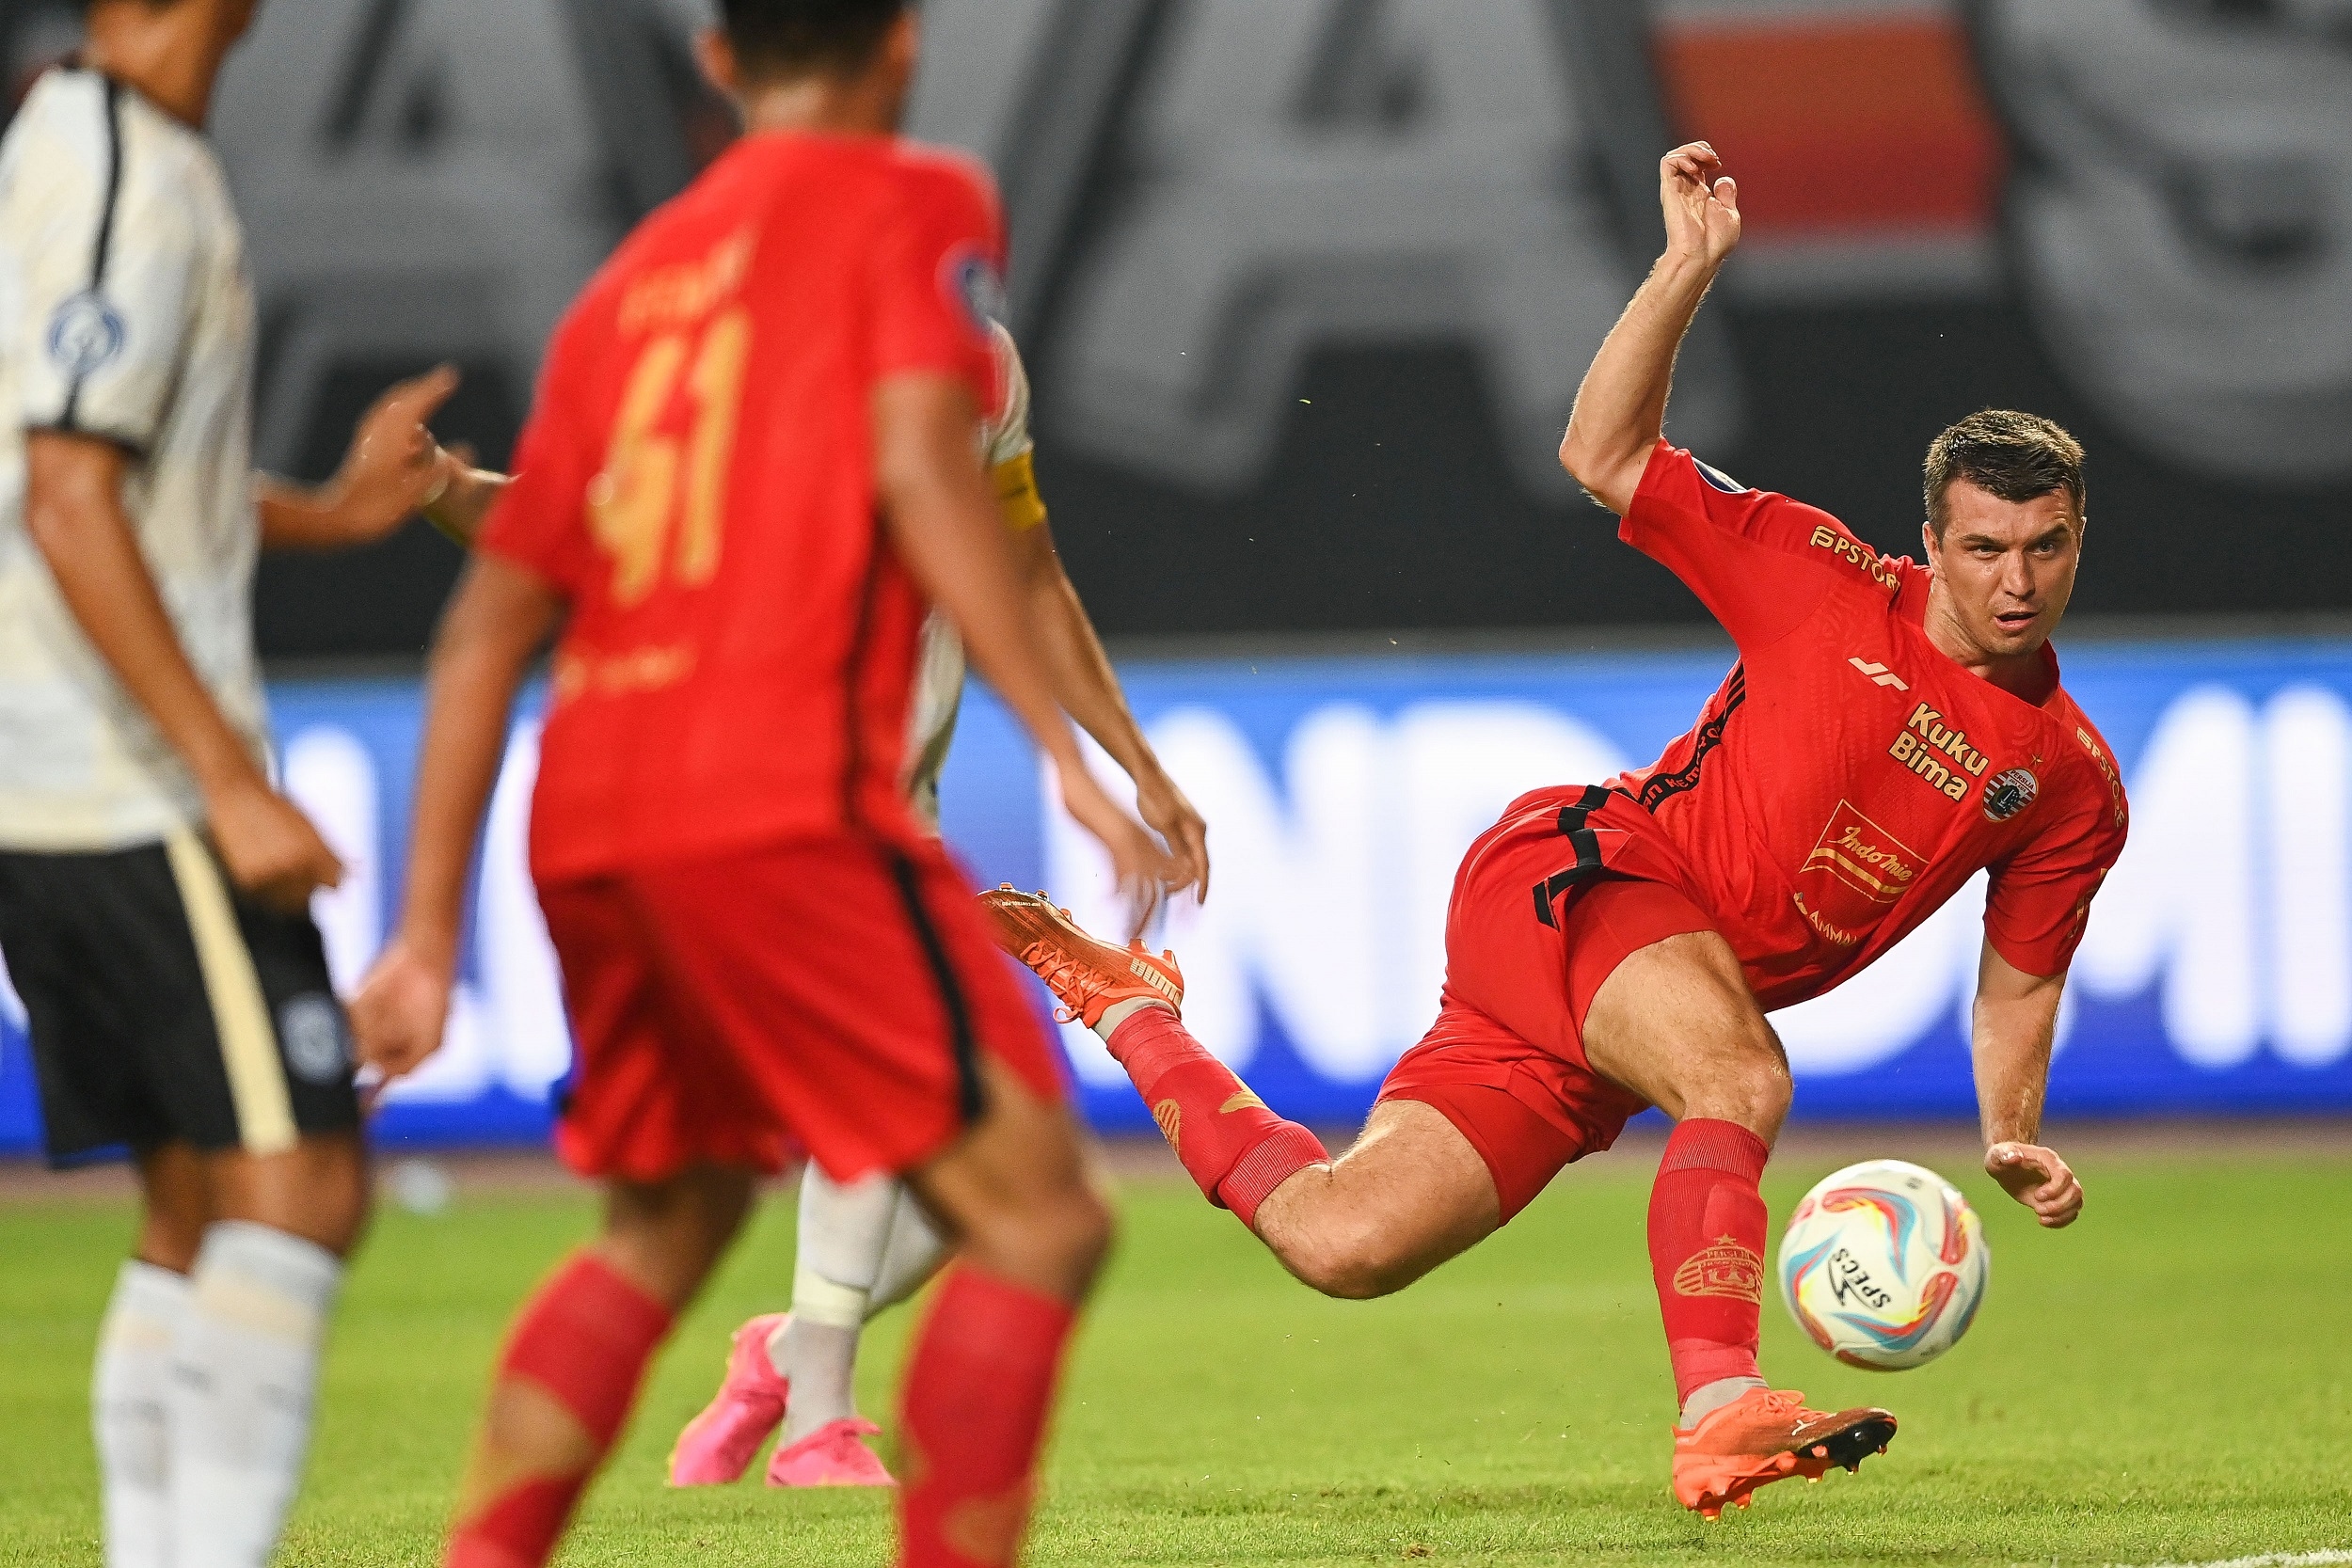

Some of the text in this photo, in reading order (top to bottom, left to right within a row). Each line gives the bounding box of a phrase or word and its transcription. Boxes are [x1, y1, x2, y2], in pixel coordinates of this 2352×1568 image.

[1888, 730, 1969, 801] Bima
[1907, 702, 1990, 777] Kuku
[2010, 769, 2035, 790] PERSIJA
[1835, 1247, 1892, 1308] SPECS
